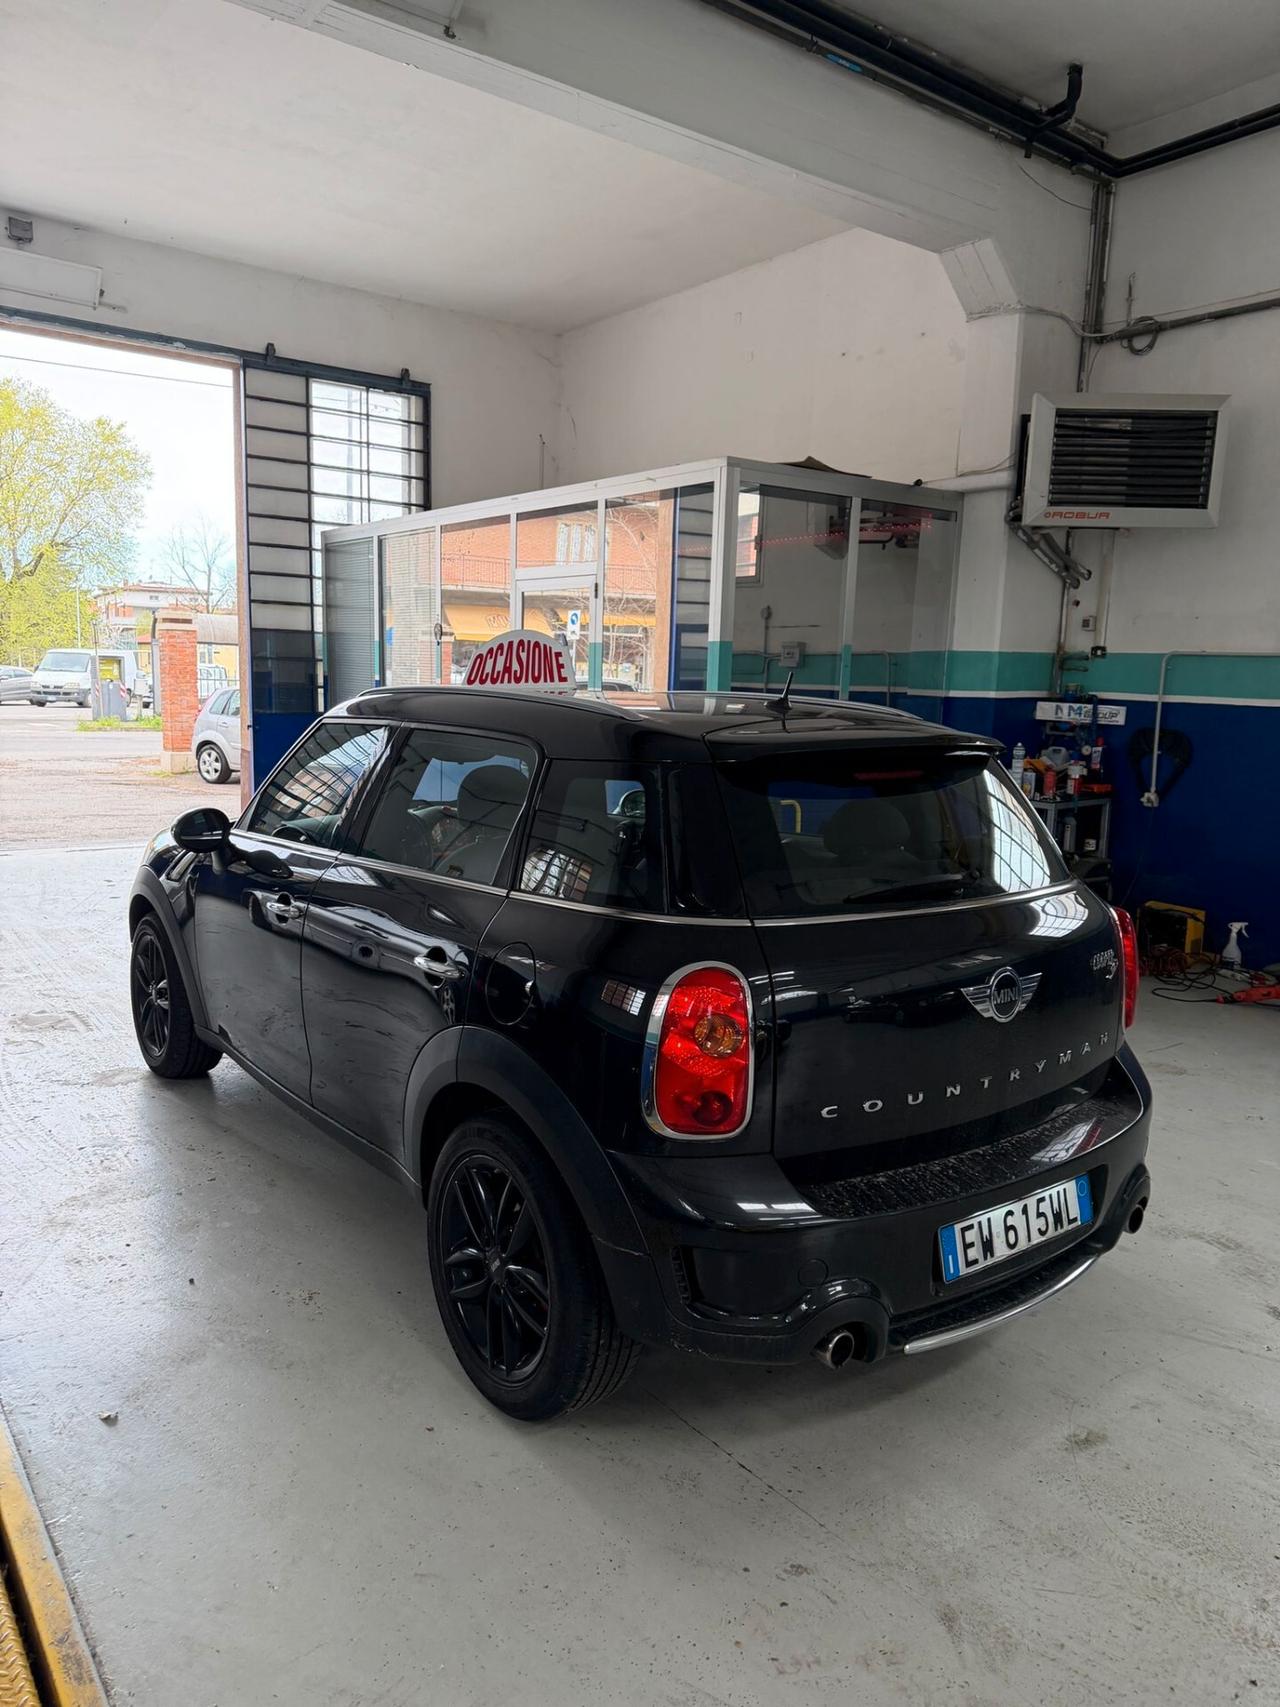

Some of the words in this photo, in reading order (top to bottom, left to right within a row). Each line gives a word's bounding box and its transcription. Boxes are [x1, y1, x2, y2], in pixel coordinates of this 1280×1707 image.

[467, 639, 568, 685] OCCASIONE
[994, 986, 1019, 1004] MINI
[820, 1032, 1109, 1119] COUNTRYMAN
[960, 1217, 994, 1268] EW
[1003, 1187, 1078, 1250] 615WL
